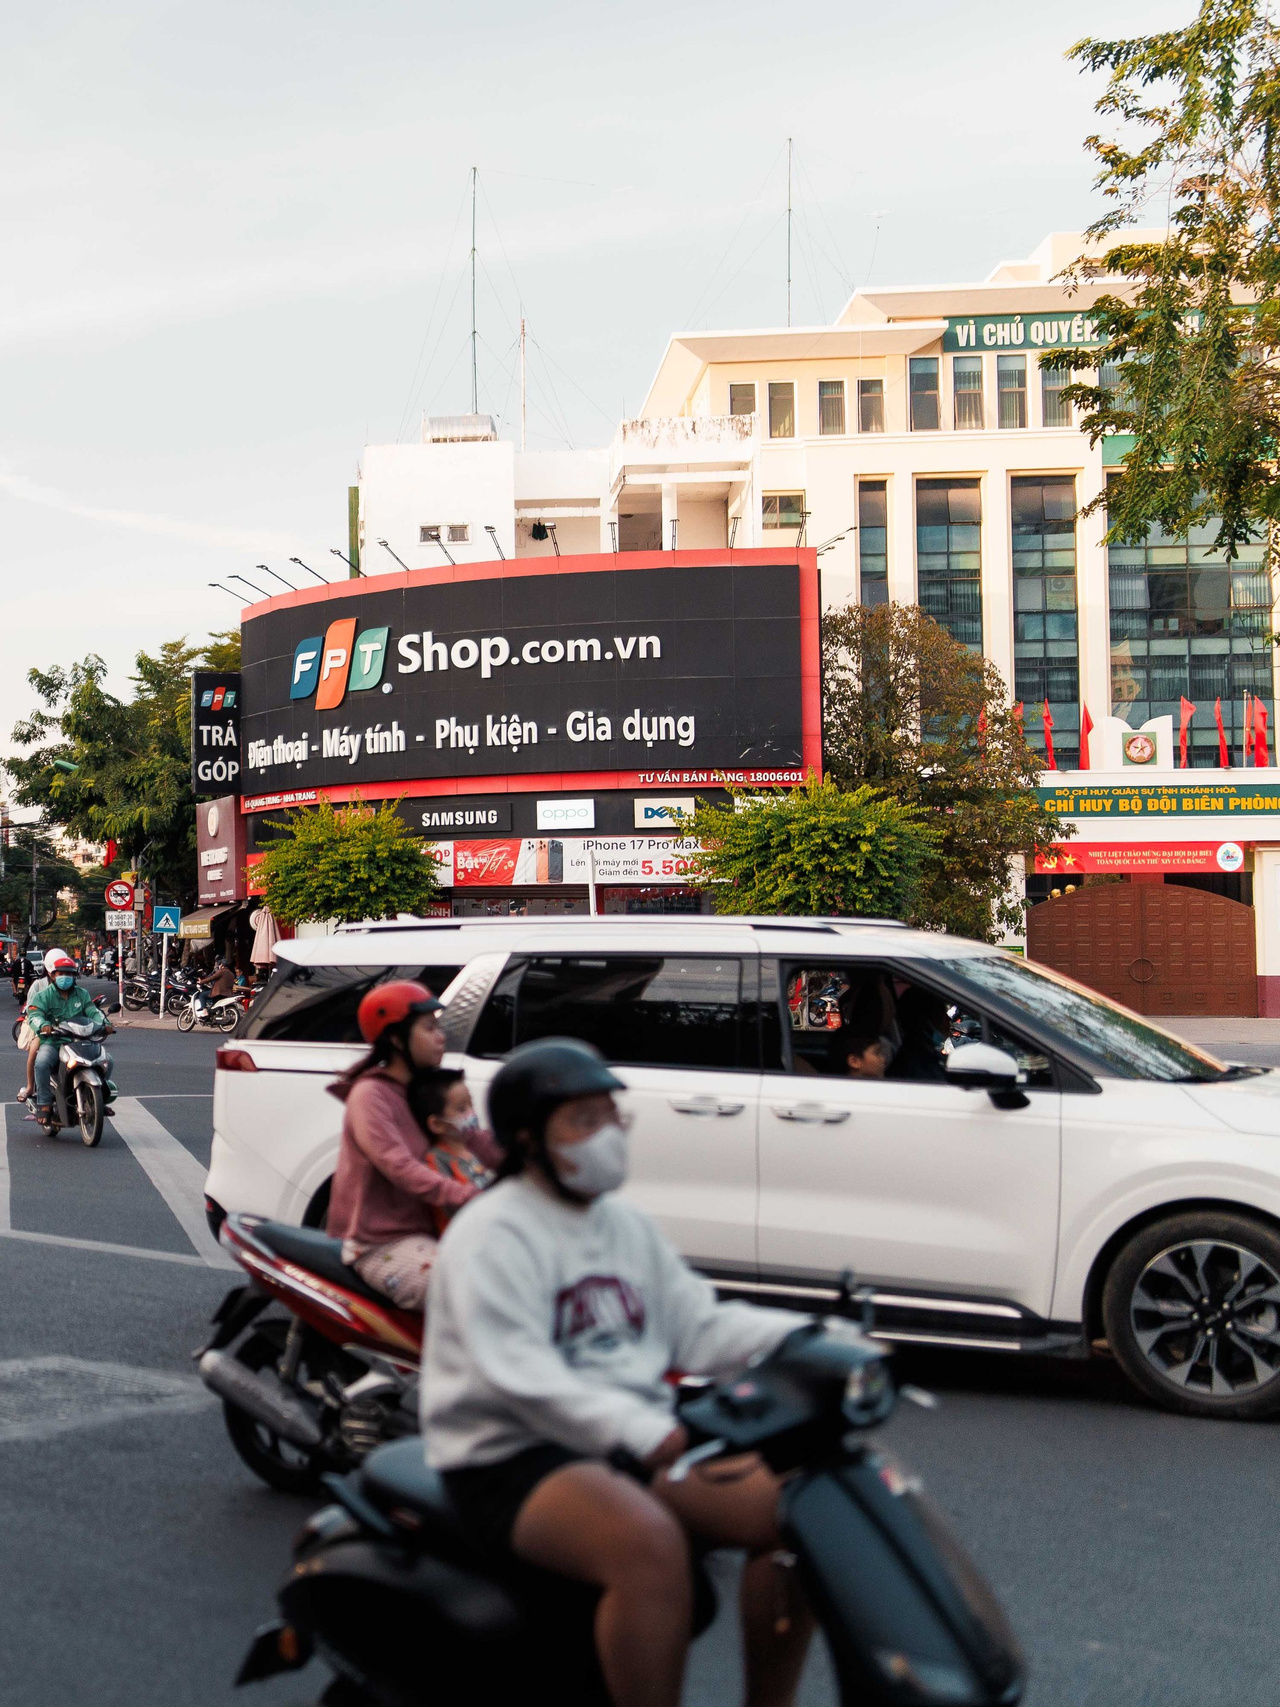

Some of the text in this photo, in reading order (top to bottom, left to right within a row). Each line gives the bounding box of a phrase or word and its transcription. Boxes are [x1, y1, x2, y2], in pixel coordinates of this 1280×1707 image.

[955, 318, 976, 348] VÌ
[982, 315, 1024, 346] CHỦ
[1029, 312, 1099, 346] QUYỀN
[293, 630, 661, 695] FPT Shop.com.vn
[202, 690, 236, 706] FPT
[198, 719, 238, 747] TRẢ
[248, 739, 273, 775] Điện
[273, 731, 309, 769] thoại
[322, 726, 361, 765] Máy
[365, 720, 406, 755] tính
[435, 716, 479, 755] Phụ
[486, 714, 538, 753] kiện
[566, 709, 612, 743] Gia
[622, 708, 695, 748] dụng
[197, 756, 240, 782] GÓP
[638, 773, 655, 783] TƯ
[657, 769, 681, 783] VẤN
[683, 770, 707, 783] BÁN
[749, 772, 804, 782] 18006601
[283, 793, 295, 803] NHA
[295, 791, 316, 801] TRANG
[1055, 785, 1237, 797] BỘ CHỈ HUY QUÂN SỰ TỈNH KHÁNH HÒA
[1045, 795, 1074, 812] CHỈ
[1080, 798, 1112, 812] HUY
[1119, 796, 1142, 814] BỘ
[1147, 796, 1177, 814] ĐỘI
[1182, 795, 1224, 811] BIÊN
[1229, 793, 1280, 811] PHÒN
[421, 809, 498, 827] SAMSUNG
[542, 808, 589, 820] oppo
[583, 839, 700, 851] iPhone 17 Pro Max
[1088, 850, 1108, 859] NHIỆT
[1123, 849, 1141, 858] CHÀO
[1143, 849, 1161, 858] MỪNG
[570, 857, 586, 867] Lên
[602, 857, 622, 869] máy
[624, 857, 639, 867] mới
[1096, 858, 1113, 866] TOÀN
[1161, 857, 1171, 865] XIV
[598, 866, 620, 877] Giảm
[622, 865, 639, 876] đến
